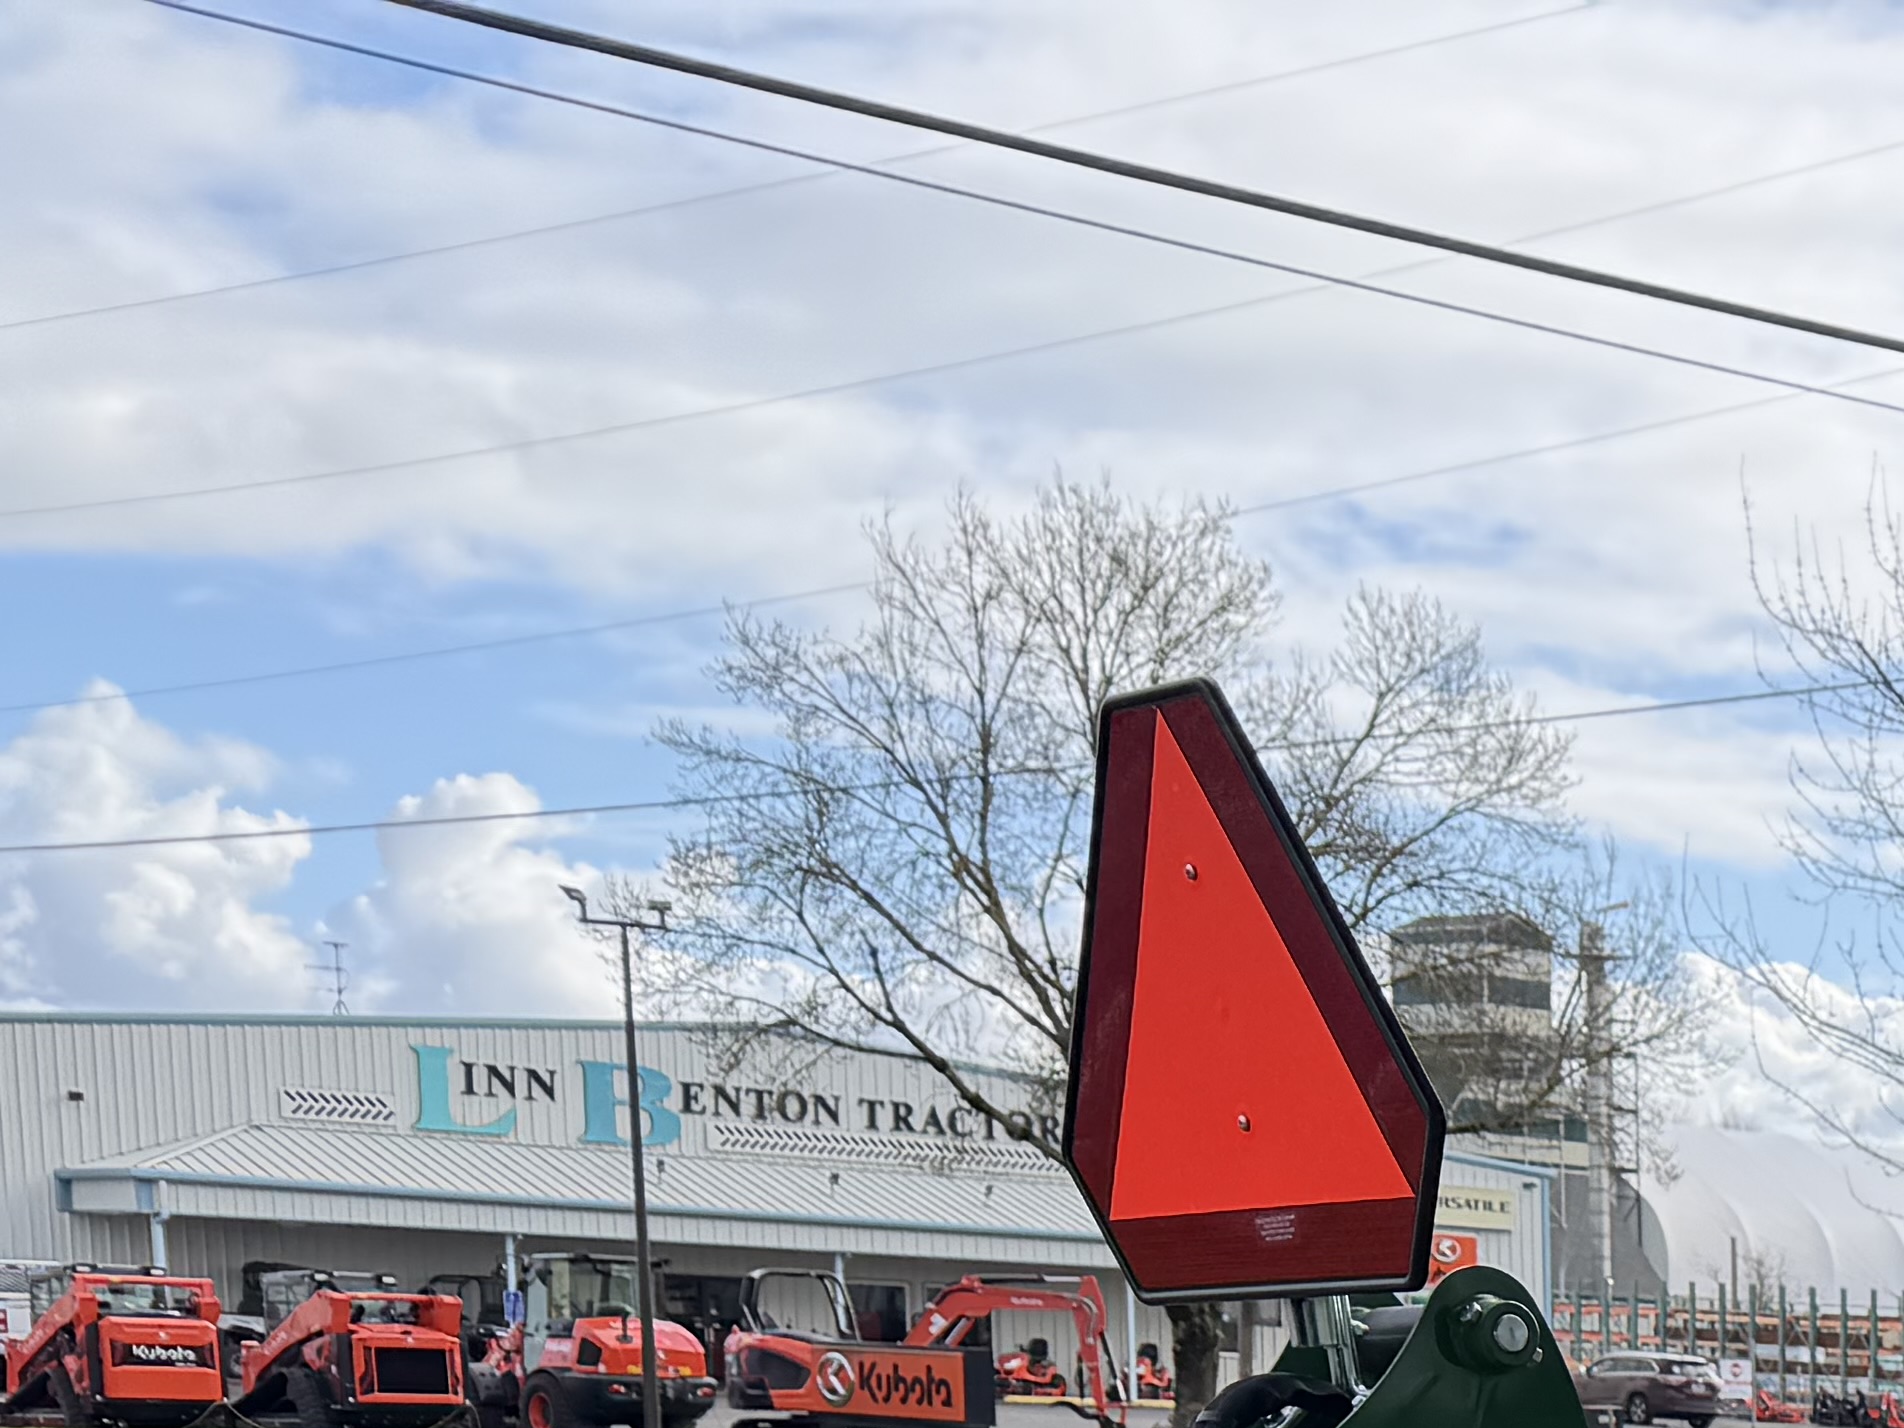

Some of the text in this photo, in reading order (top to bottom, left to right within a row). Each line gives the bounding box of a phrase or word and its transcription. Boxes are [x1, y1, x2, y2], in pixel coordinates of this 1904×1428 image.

[409, 1043, 1061, 1148] LINN BENTON TRACTOR
[1439, 1196, 1511, 1213] RSATILE
[131, 1344, 197, 1361] Kubota
[858, 1360, 953, 1408] Kubota
